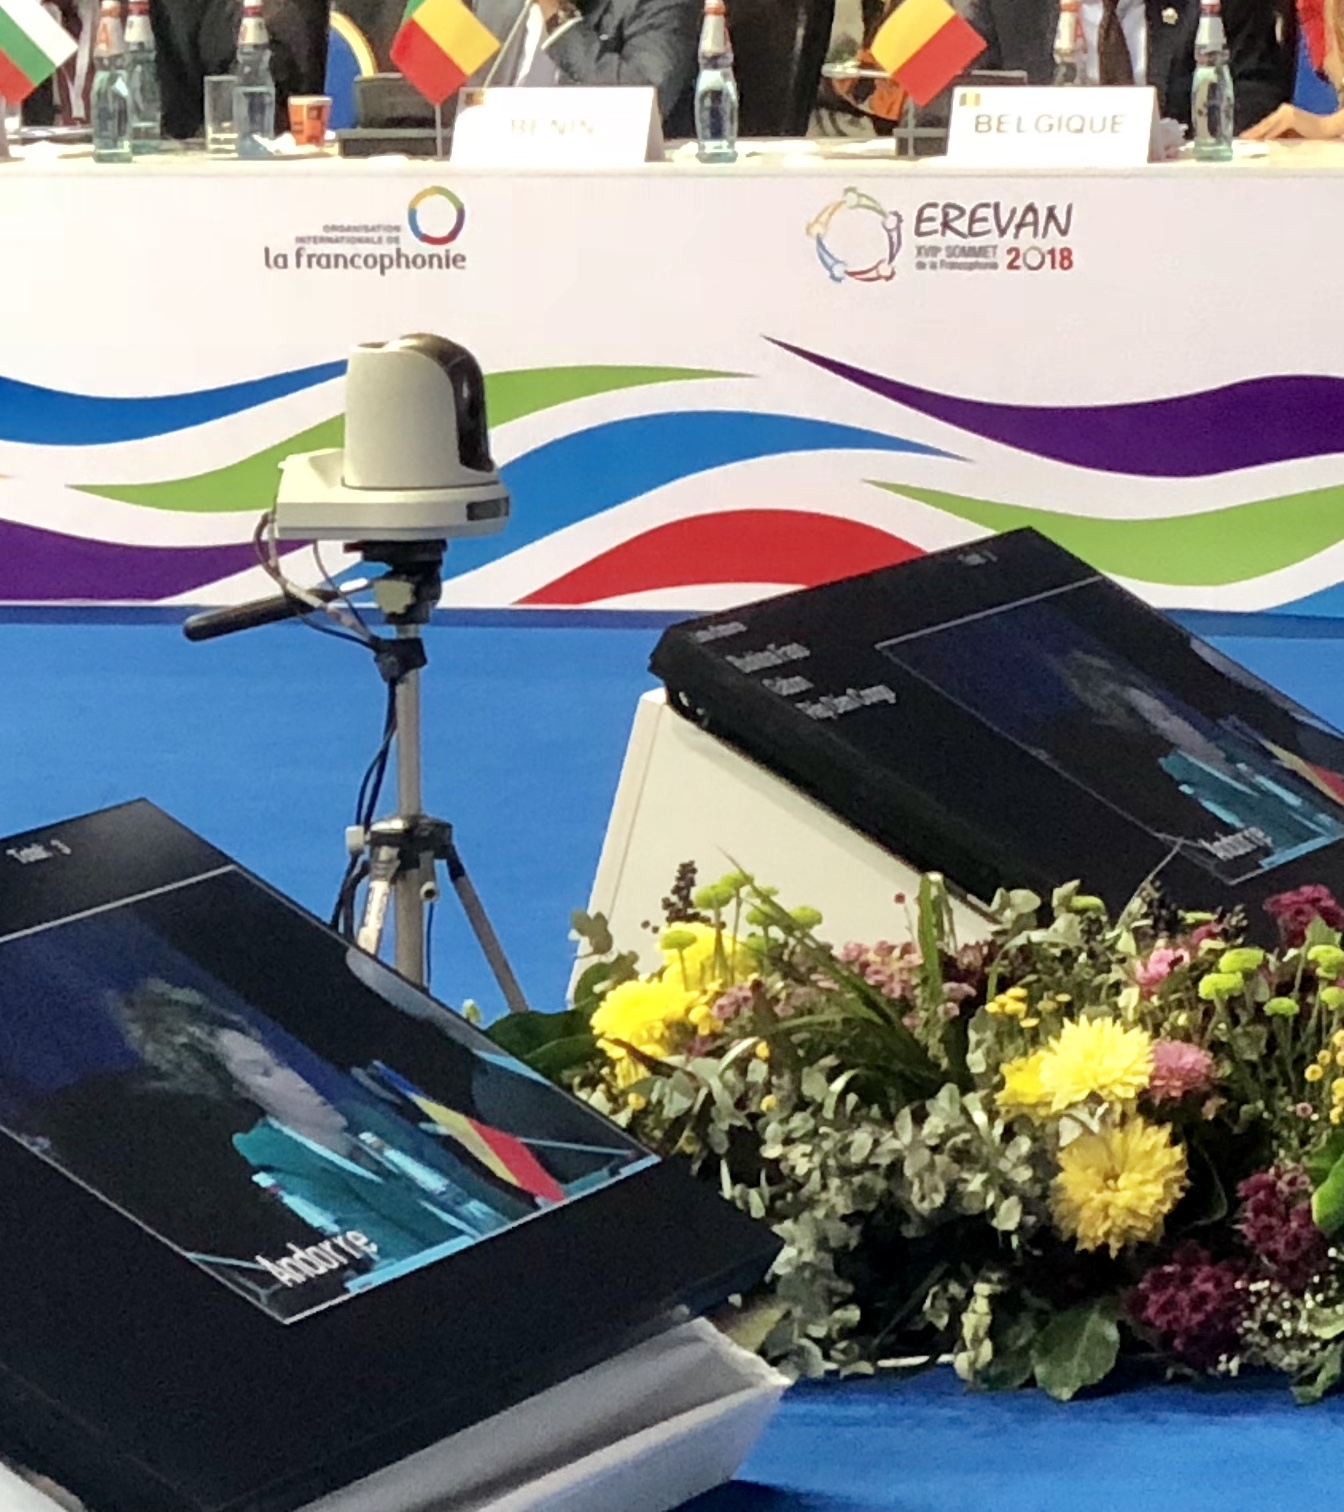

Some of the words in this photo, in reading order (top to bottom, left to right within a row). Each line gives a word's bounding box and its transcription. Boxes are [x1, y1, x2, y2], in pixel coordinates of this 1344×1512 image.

[974, 113, 1127, 134] BELGIQUE
[322, 224, 401, 234] ORGANISATION
[914, 201, 1073, 239] EREVAN
[264, 246, 288, 269] la
[295, 246, 467, 276] francophonie
[945, 245, 998, 258] SOMMET
[1006, 245, 1073, 271] 2018
[255, 1230, 380, 1288] Andorre
